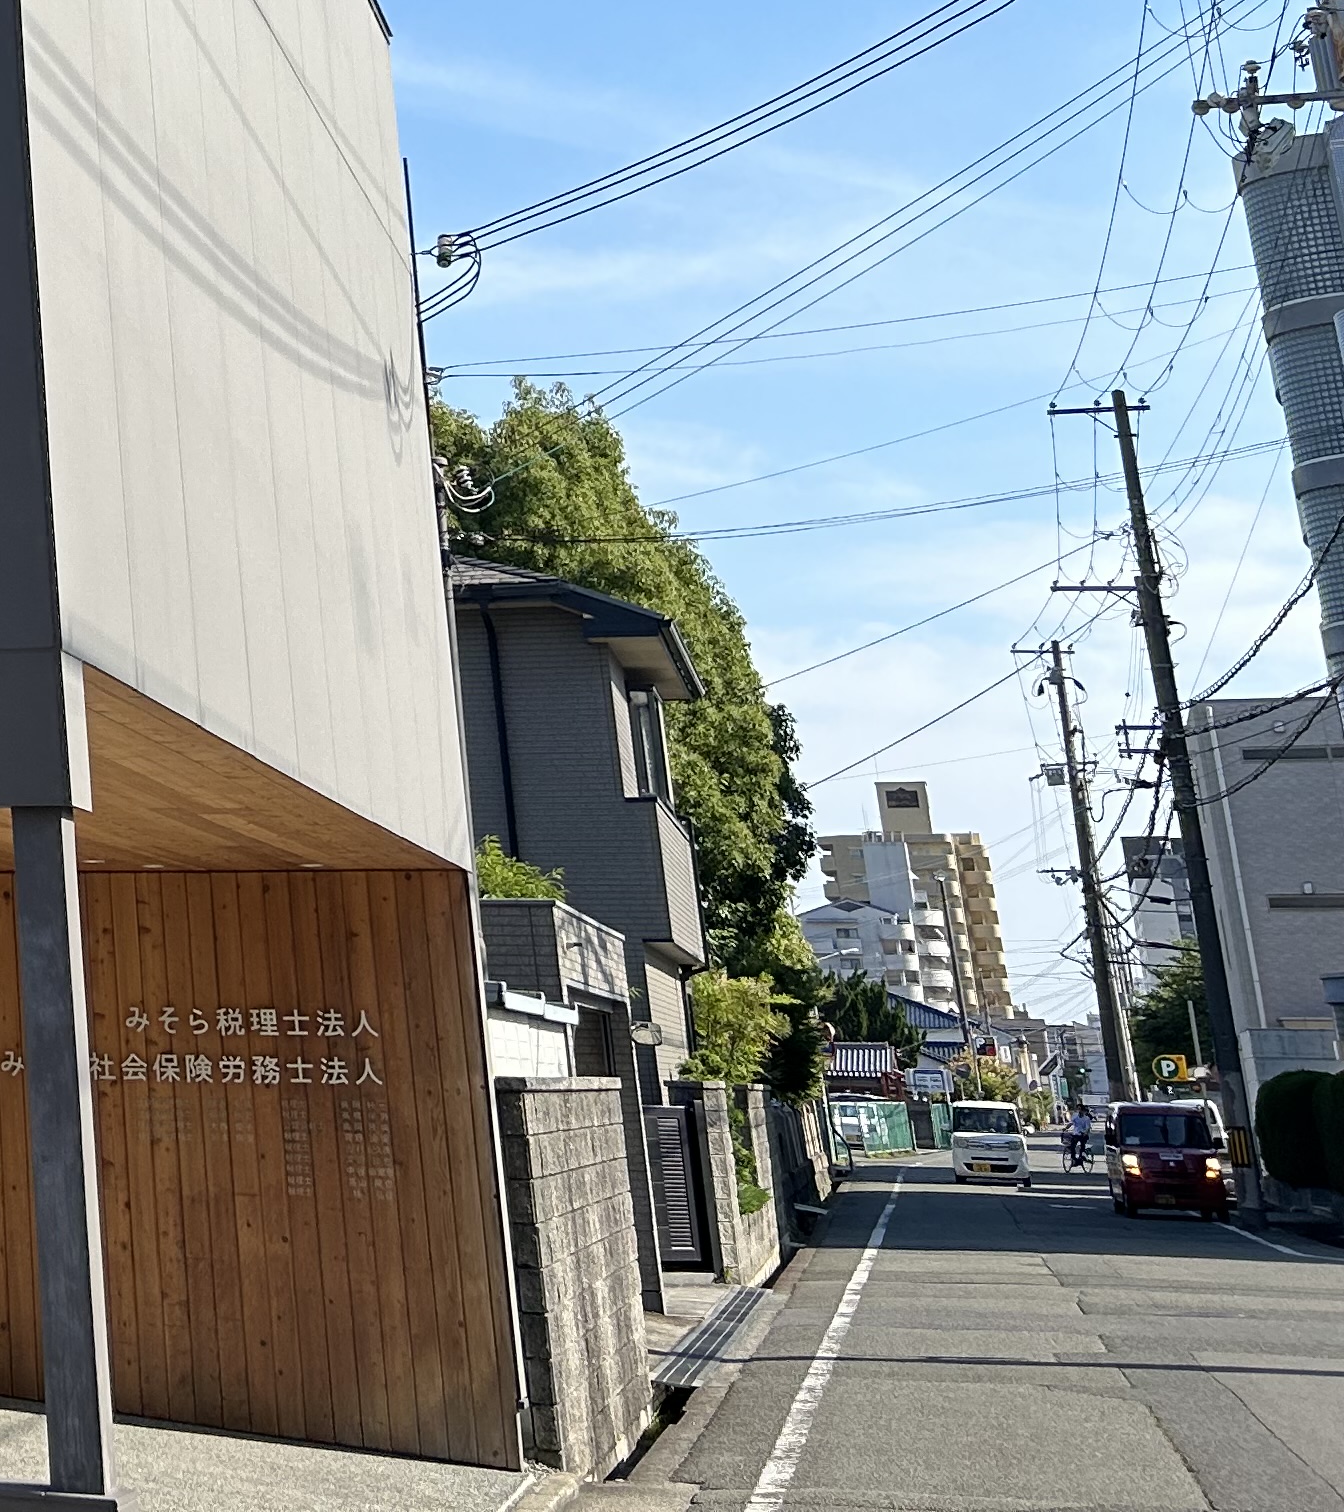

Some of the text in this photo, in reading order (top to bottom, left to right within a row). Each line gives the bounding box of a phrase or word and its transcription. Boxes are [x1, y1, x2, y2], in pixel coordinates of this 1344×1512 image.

[125, 1006, 379, 1037] みそら税理士法人
[0, 1051, 383, 1086] み社会保険労務士法人
[1161, 1059, 1175, 1077] P
